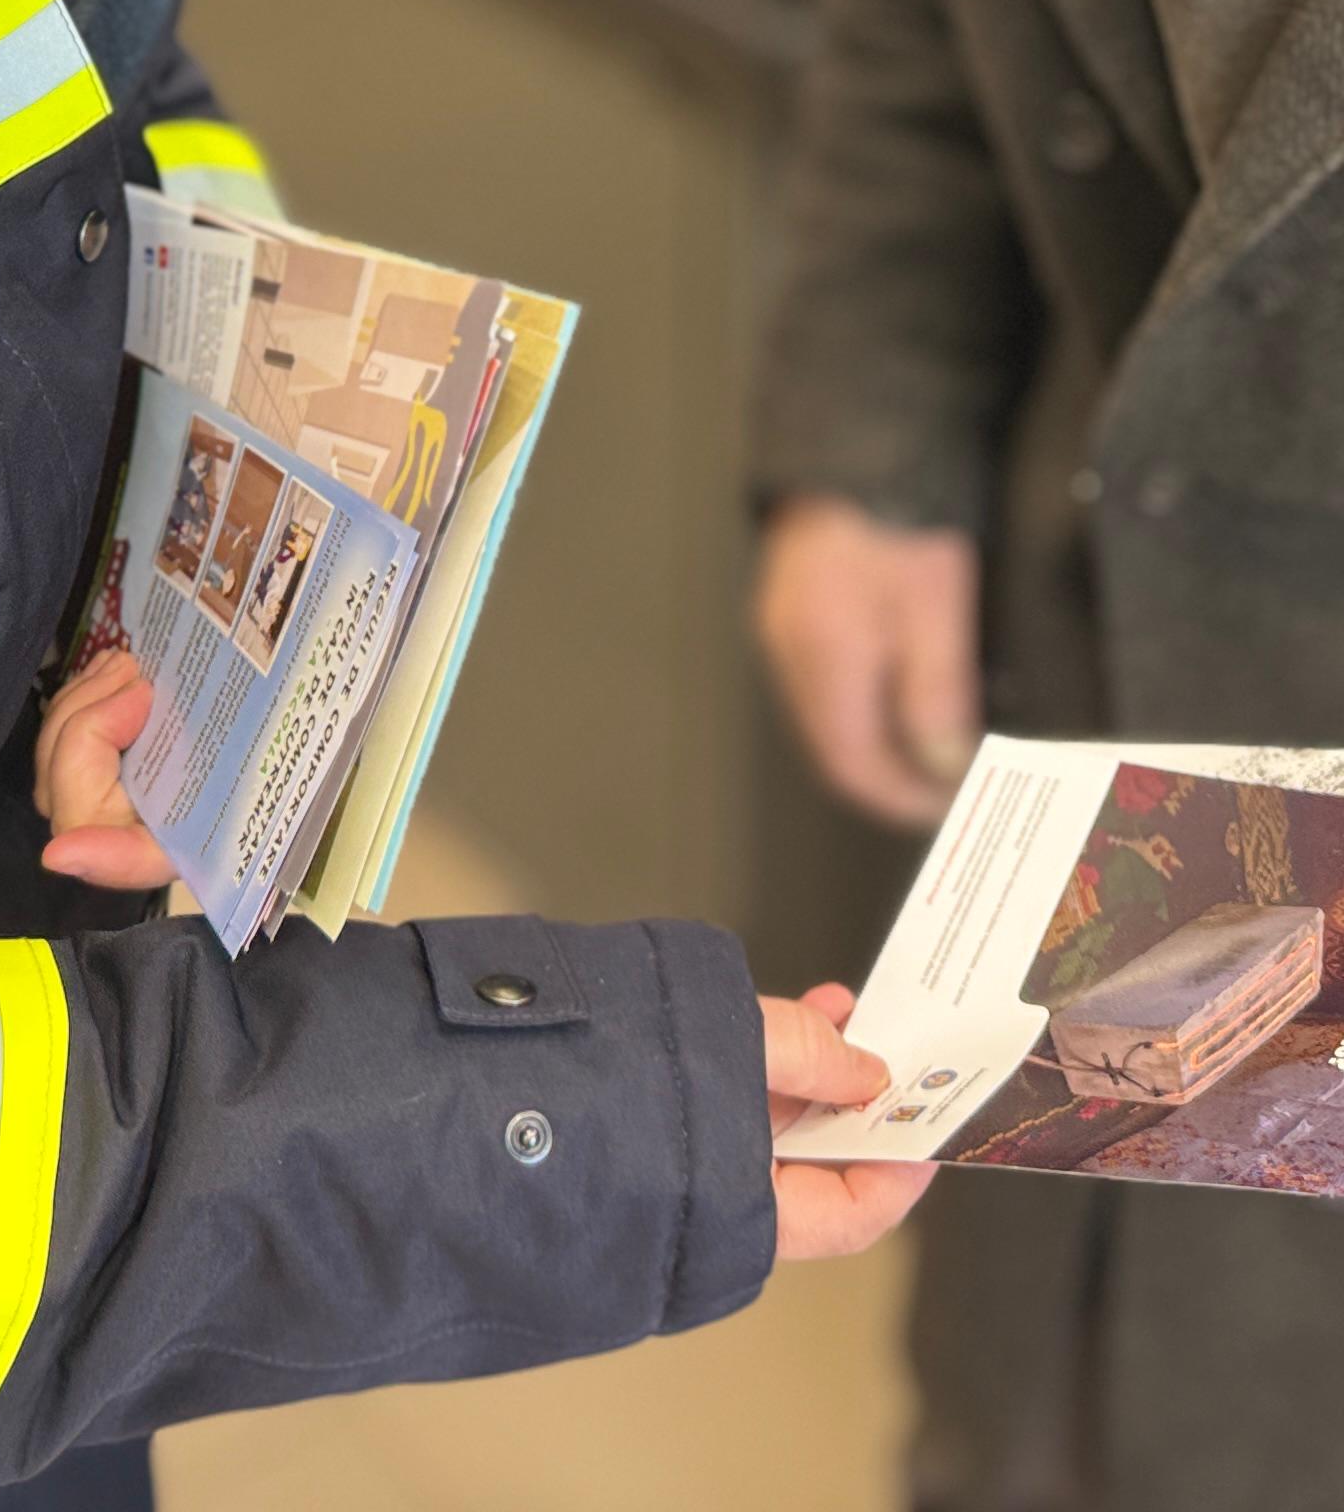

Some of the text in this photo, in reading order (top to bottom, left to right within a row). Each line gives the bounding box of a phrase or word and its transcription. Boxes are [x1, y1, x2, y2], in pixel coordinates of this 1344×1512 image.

[235, 571, 376, 882] REGULI DE COMPORTARE
[238, 584, 358, 851] IN CAZ DE CUTREMUR
[259, 562, 397, 882] REGULI DE COMPORTARE
[308, 636, 323, 666] LA
